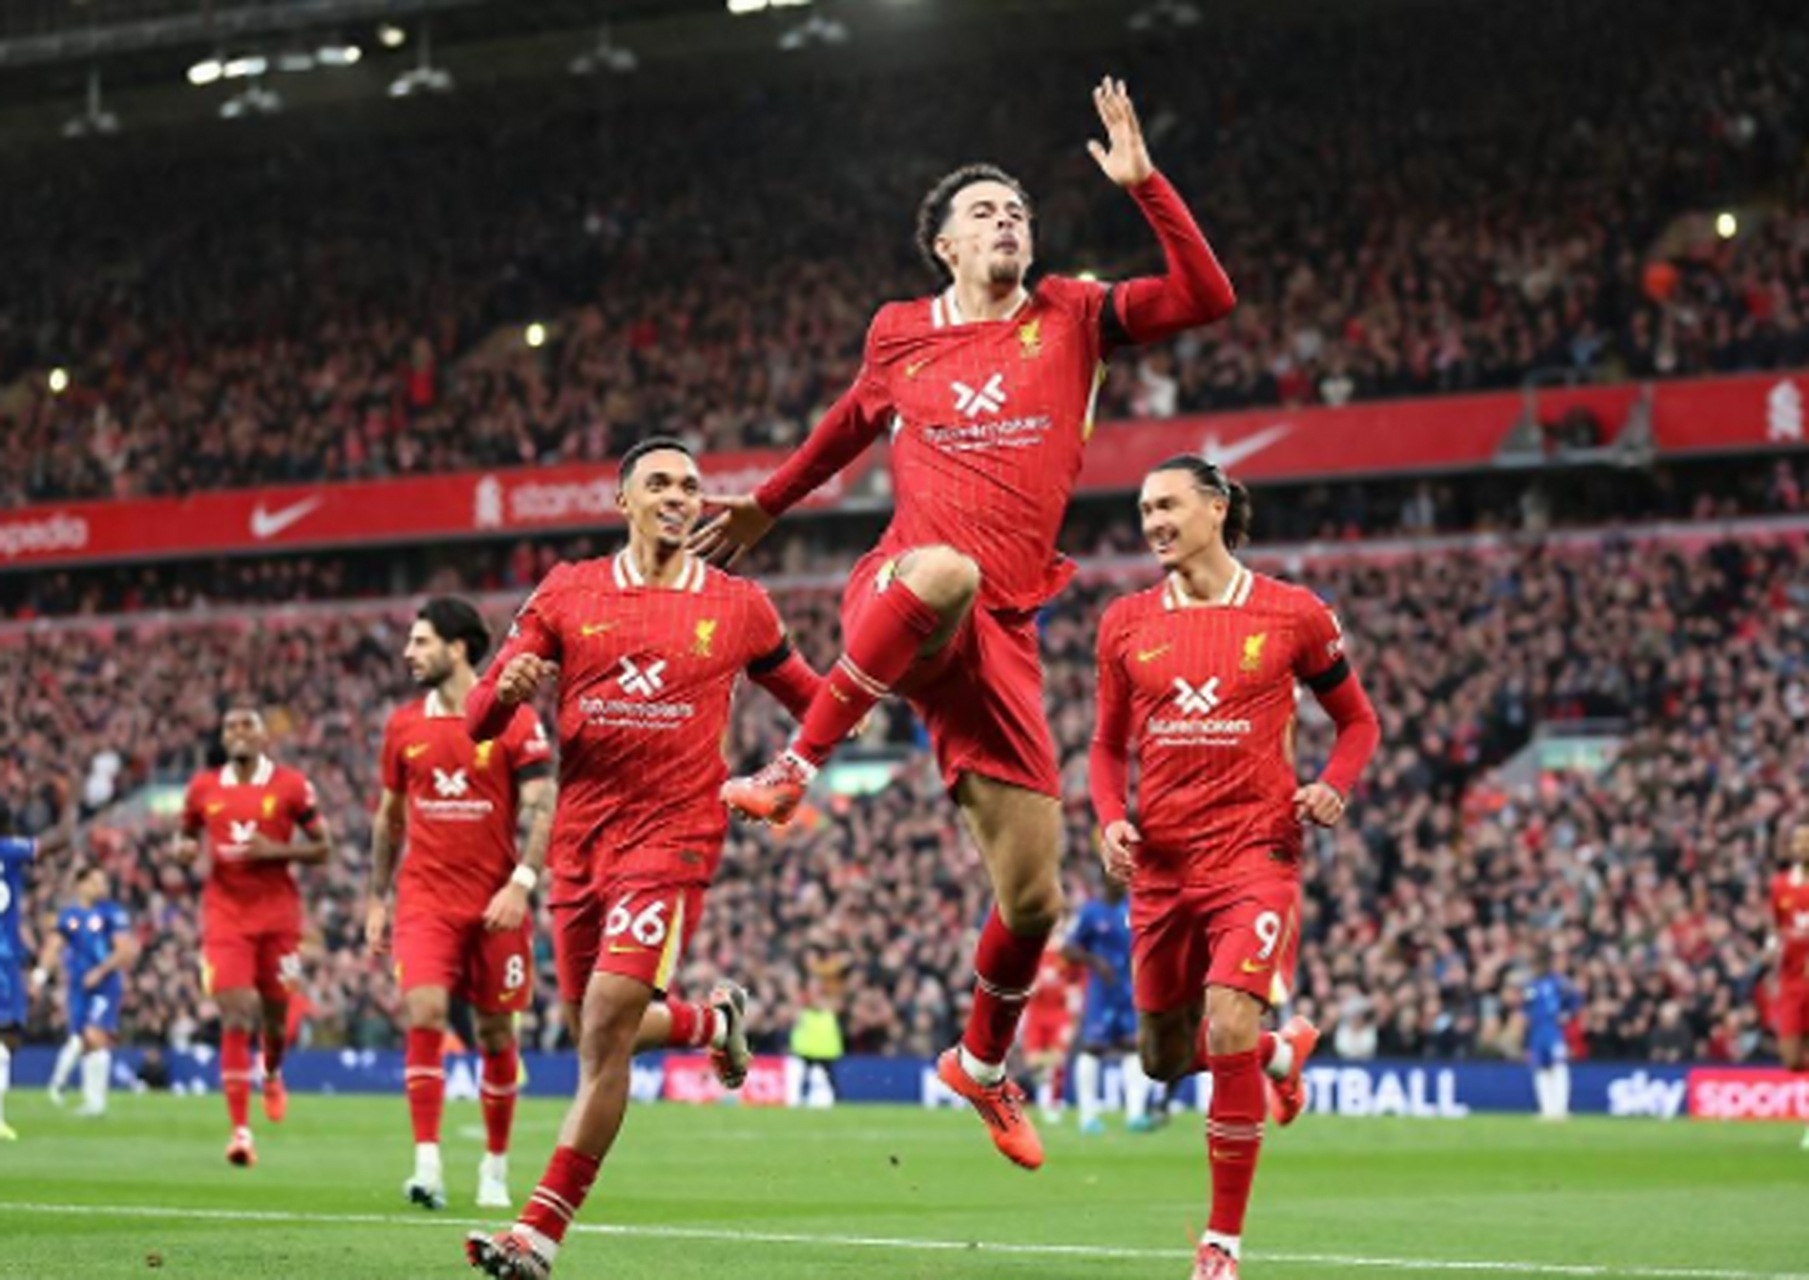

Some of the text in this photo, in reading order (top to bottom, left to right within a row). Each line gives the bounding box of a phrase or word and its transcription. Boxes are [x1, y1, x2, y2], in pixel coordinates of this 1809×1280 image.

[604, 890, 665, 946] 66
[1253, 909, 1281, 960] 9
[503, 953, 526, 990] 8
[1607, 1069, 1685, 1119] sky
